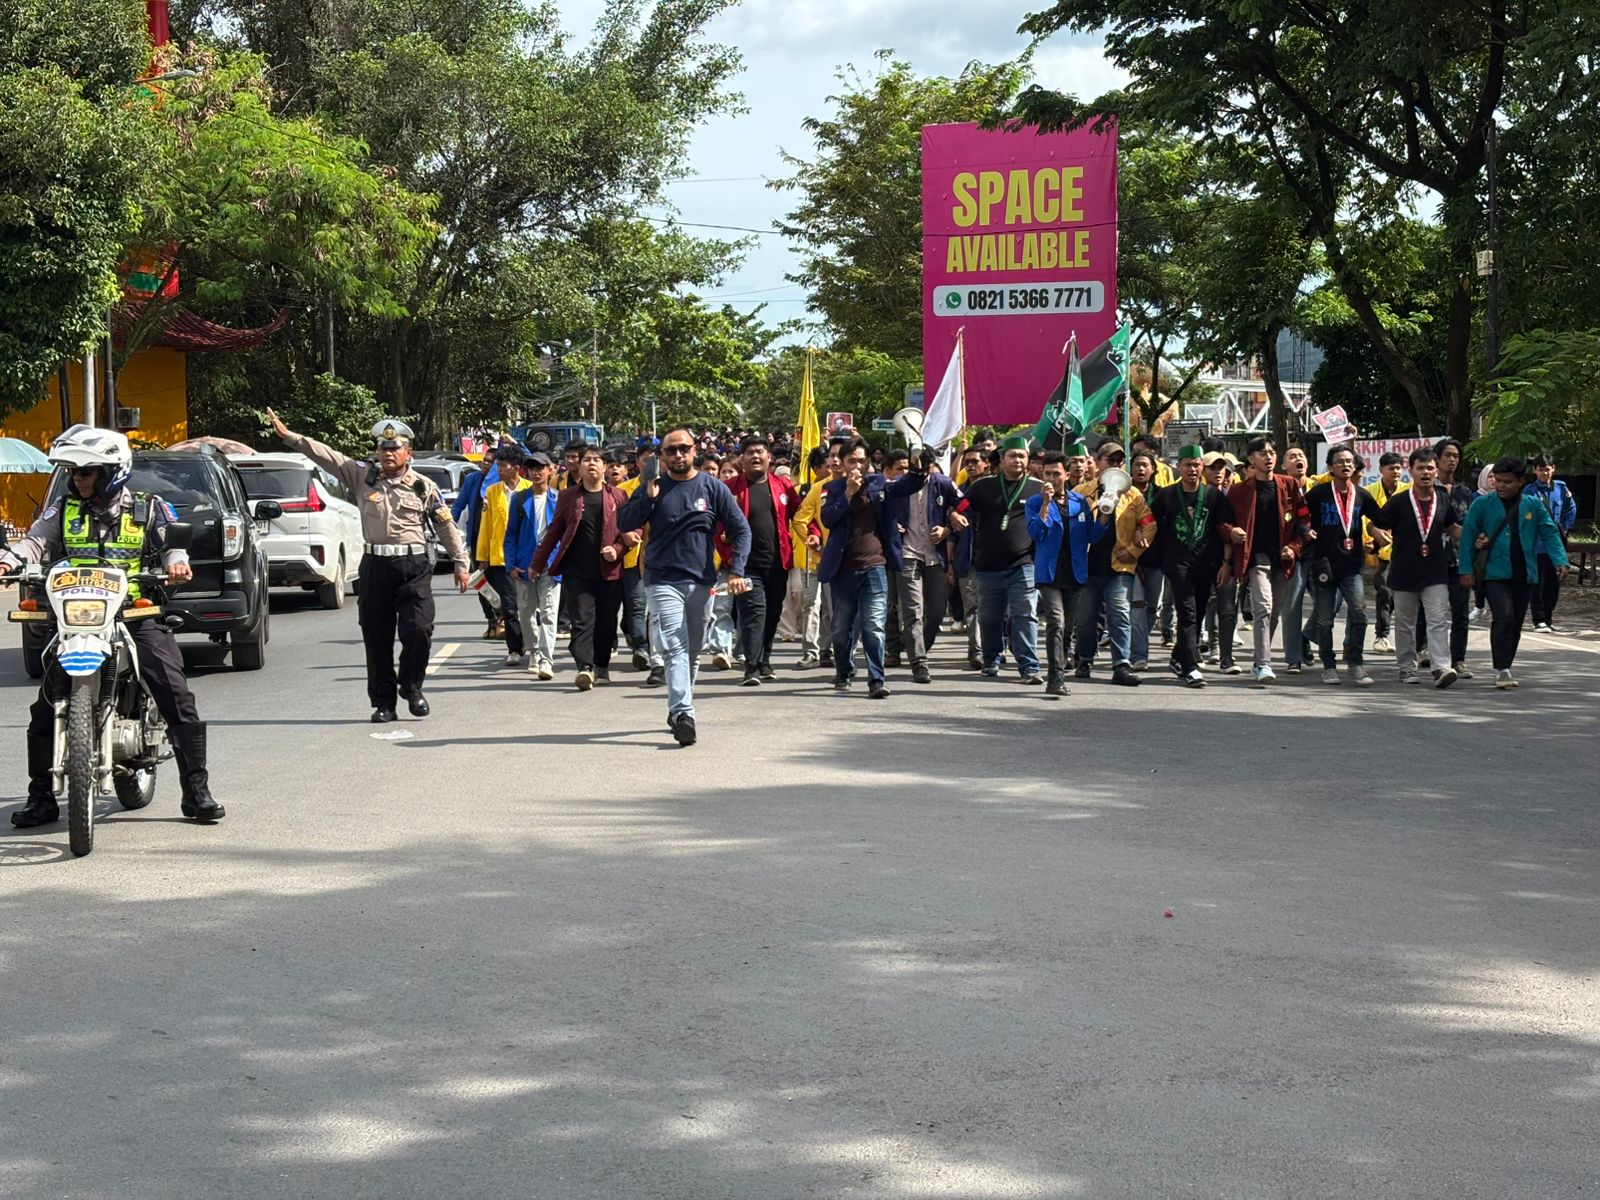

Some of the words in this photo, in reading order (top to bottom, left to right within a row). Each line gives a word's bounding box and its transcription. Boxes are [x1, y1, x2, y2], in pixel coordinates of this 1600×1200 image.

[952, 166, 1084, 227] SPACE
[946, 231, 1090, 272] AVAILABLE
[967, 289, 1004, 310] 0821
[1008, 288, 1049, 309] 5366
[1053, 287, 1092, 308] 7771
[61, 587, 109, 597] POLISI
